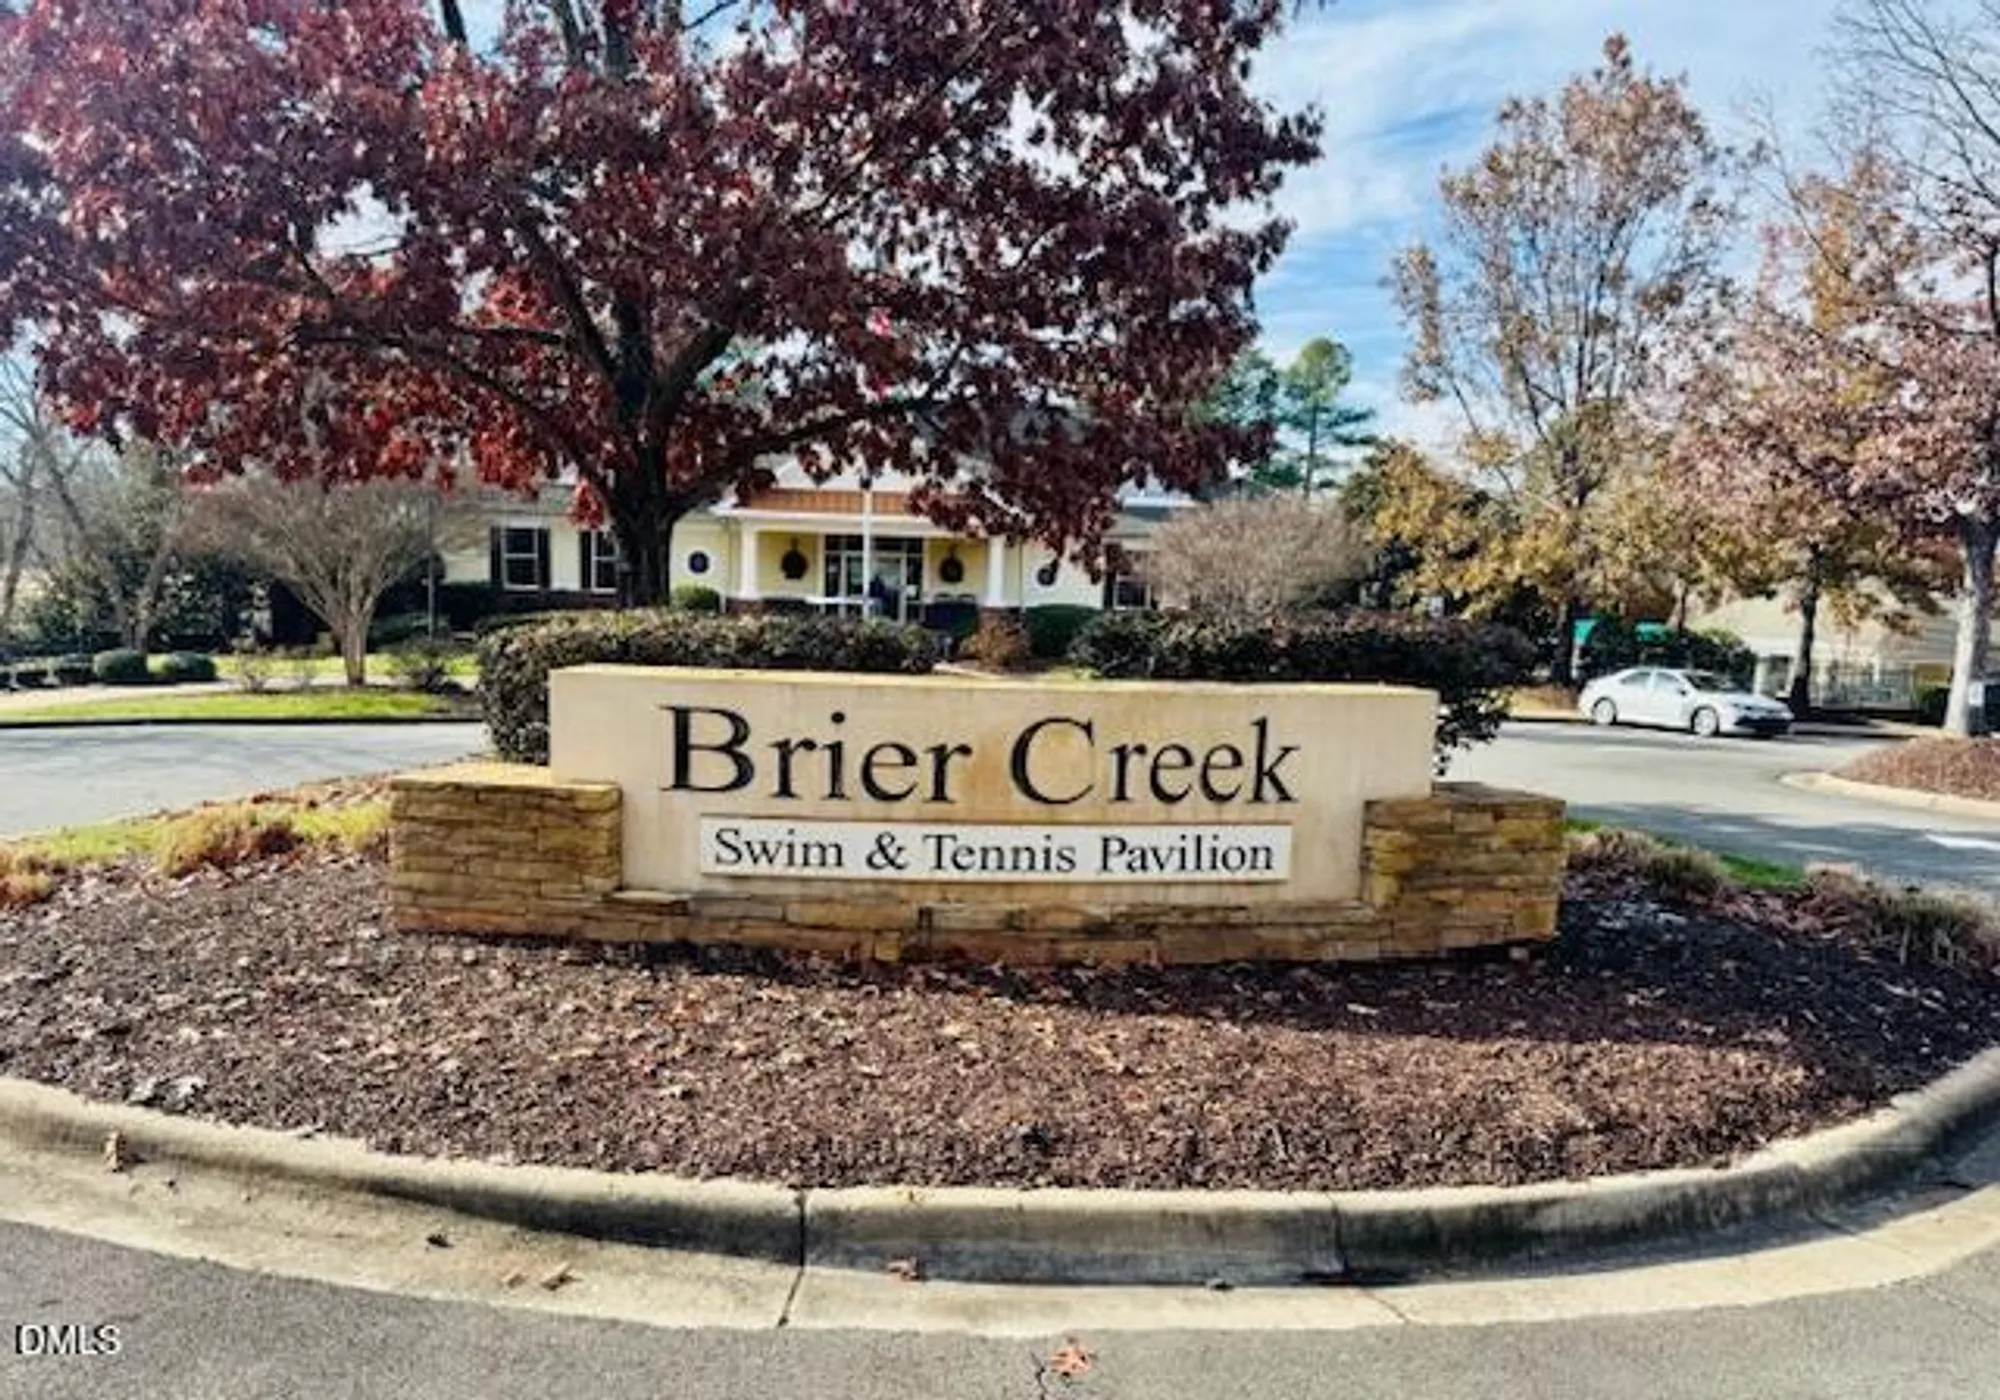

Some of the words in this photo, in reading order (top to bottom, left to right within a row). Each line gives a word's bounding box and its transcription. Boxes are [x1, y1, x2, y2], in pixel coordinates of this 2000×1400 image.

[660, 705, 973, 803] Brier
[1009, 716, 1300, 806] Creek
[713, 827, 844, 869] Swim
[865, 832, 908, 872] &
[921, 833, 1077, 874] Tennis
[1099, 834, 1275, 874] Pavilion
